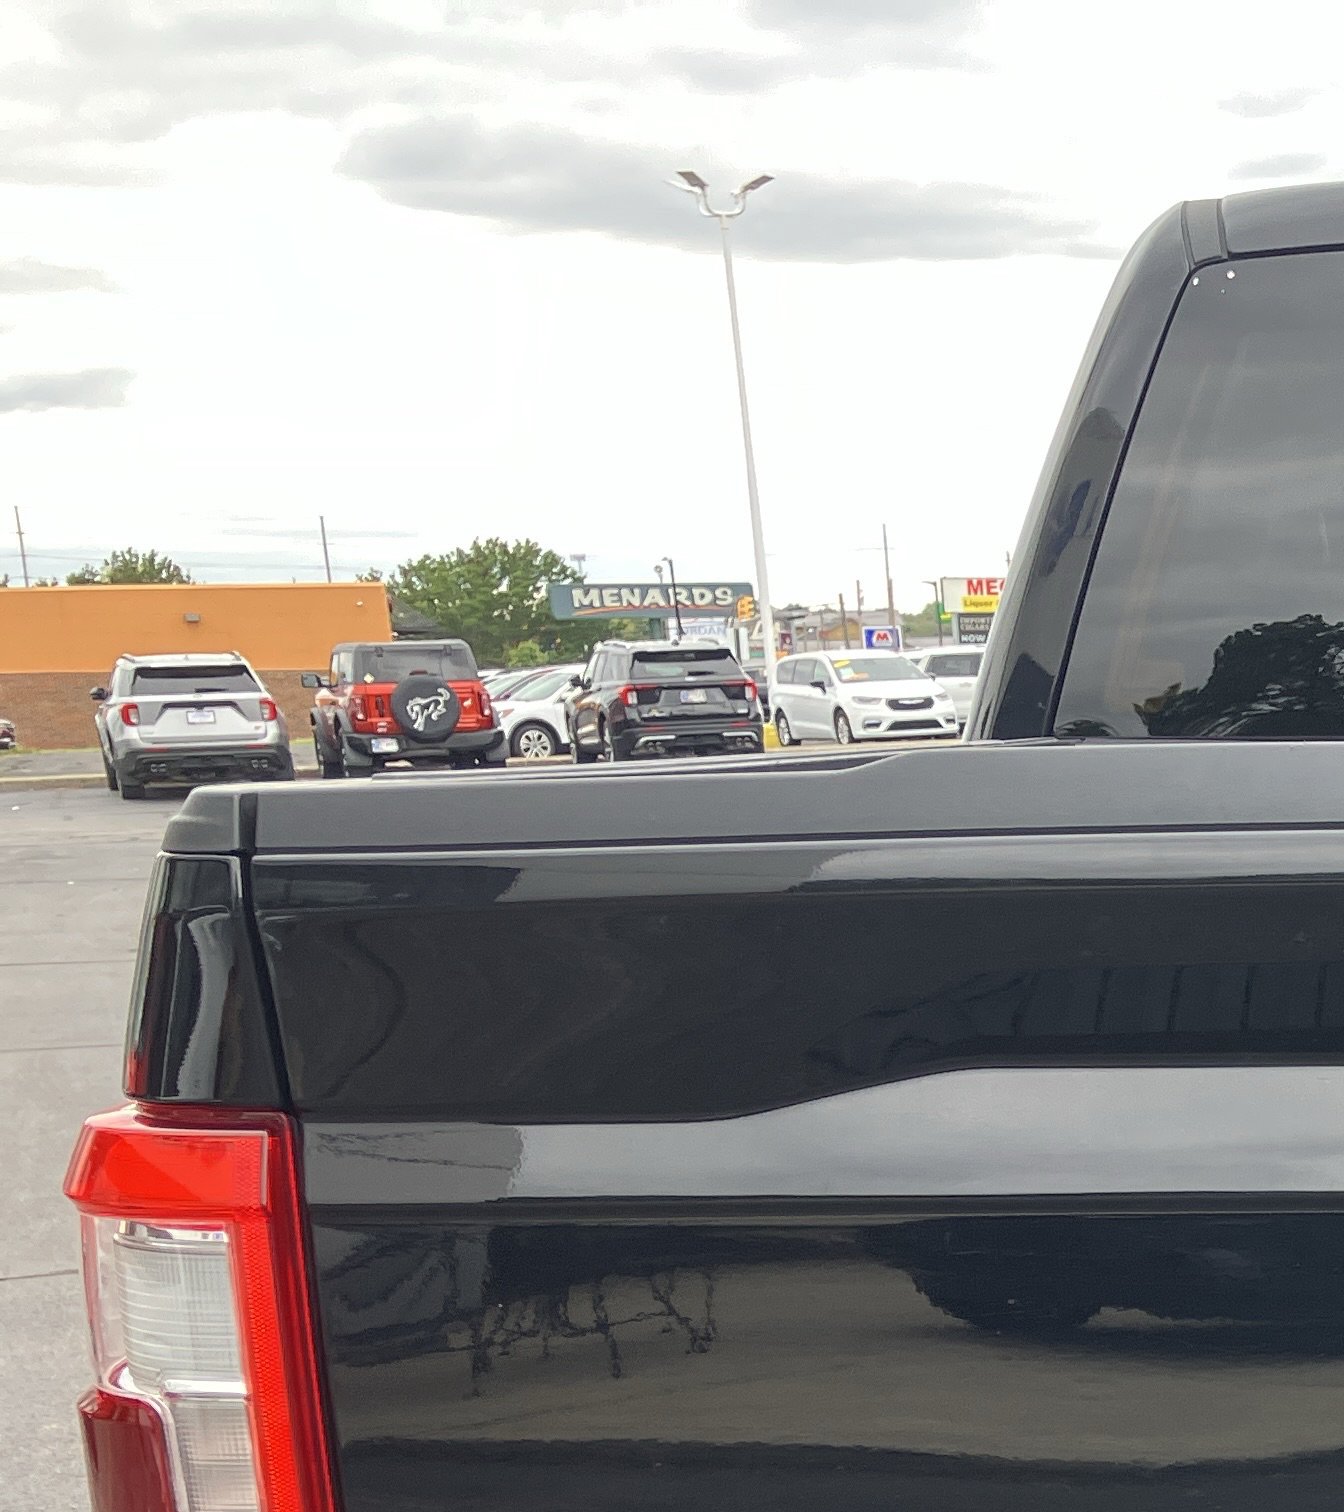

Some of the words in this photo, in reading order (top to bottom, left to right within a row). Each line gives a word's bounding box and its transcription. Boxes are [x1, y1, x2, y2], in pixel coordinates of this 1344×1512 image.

[966, 578, 1006, 596] ME
[571, 587, 733, 608] MENARDS
[961, 633, 986, 643] NOW
